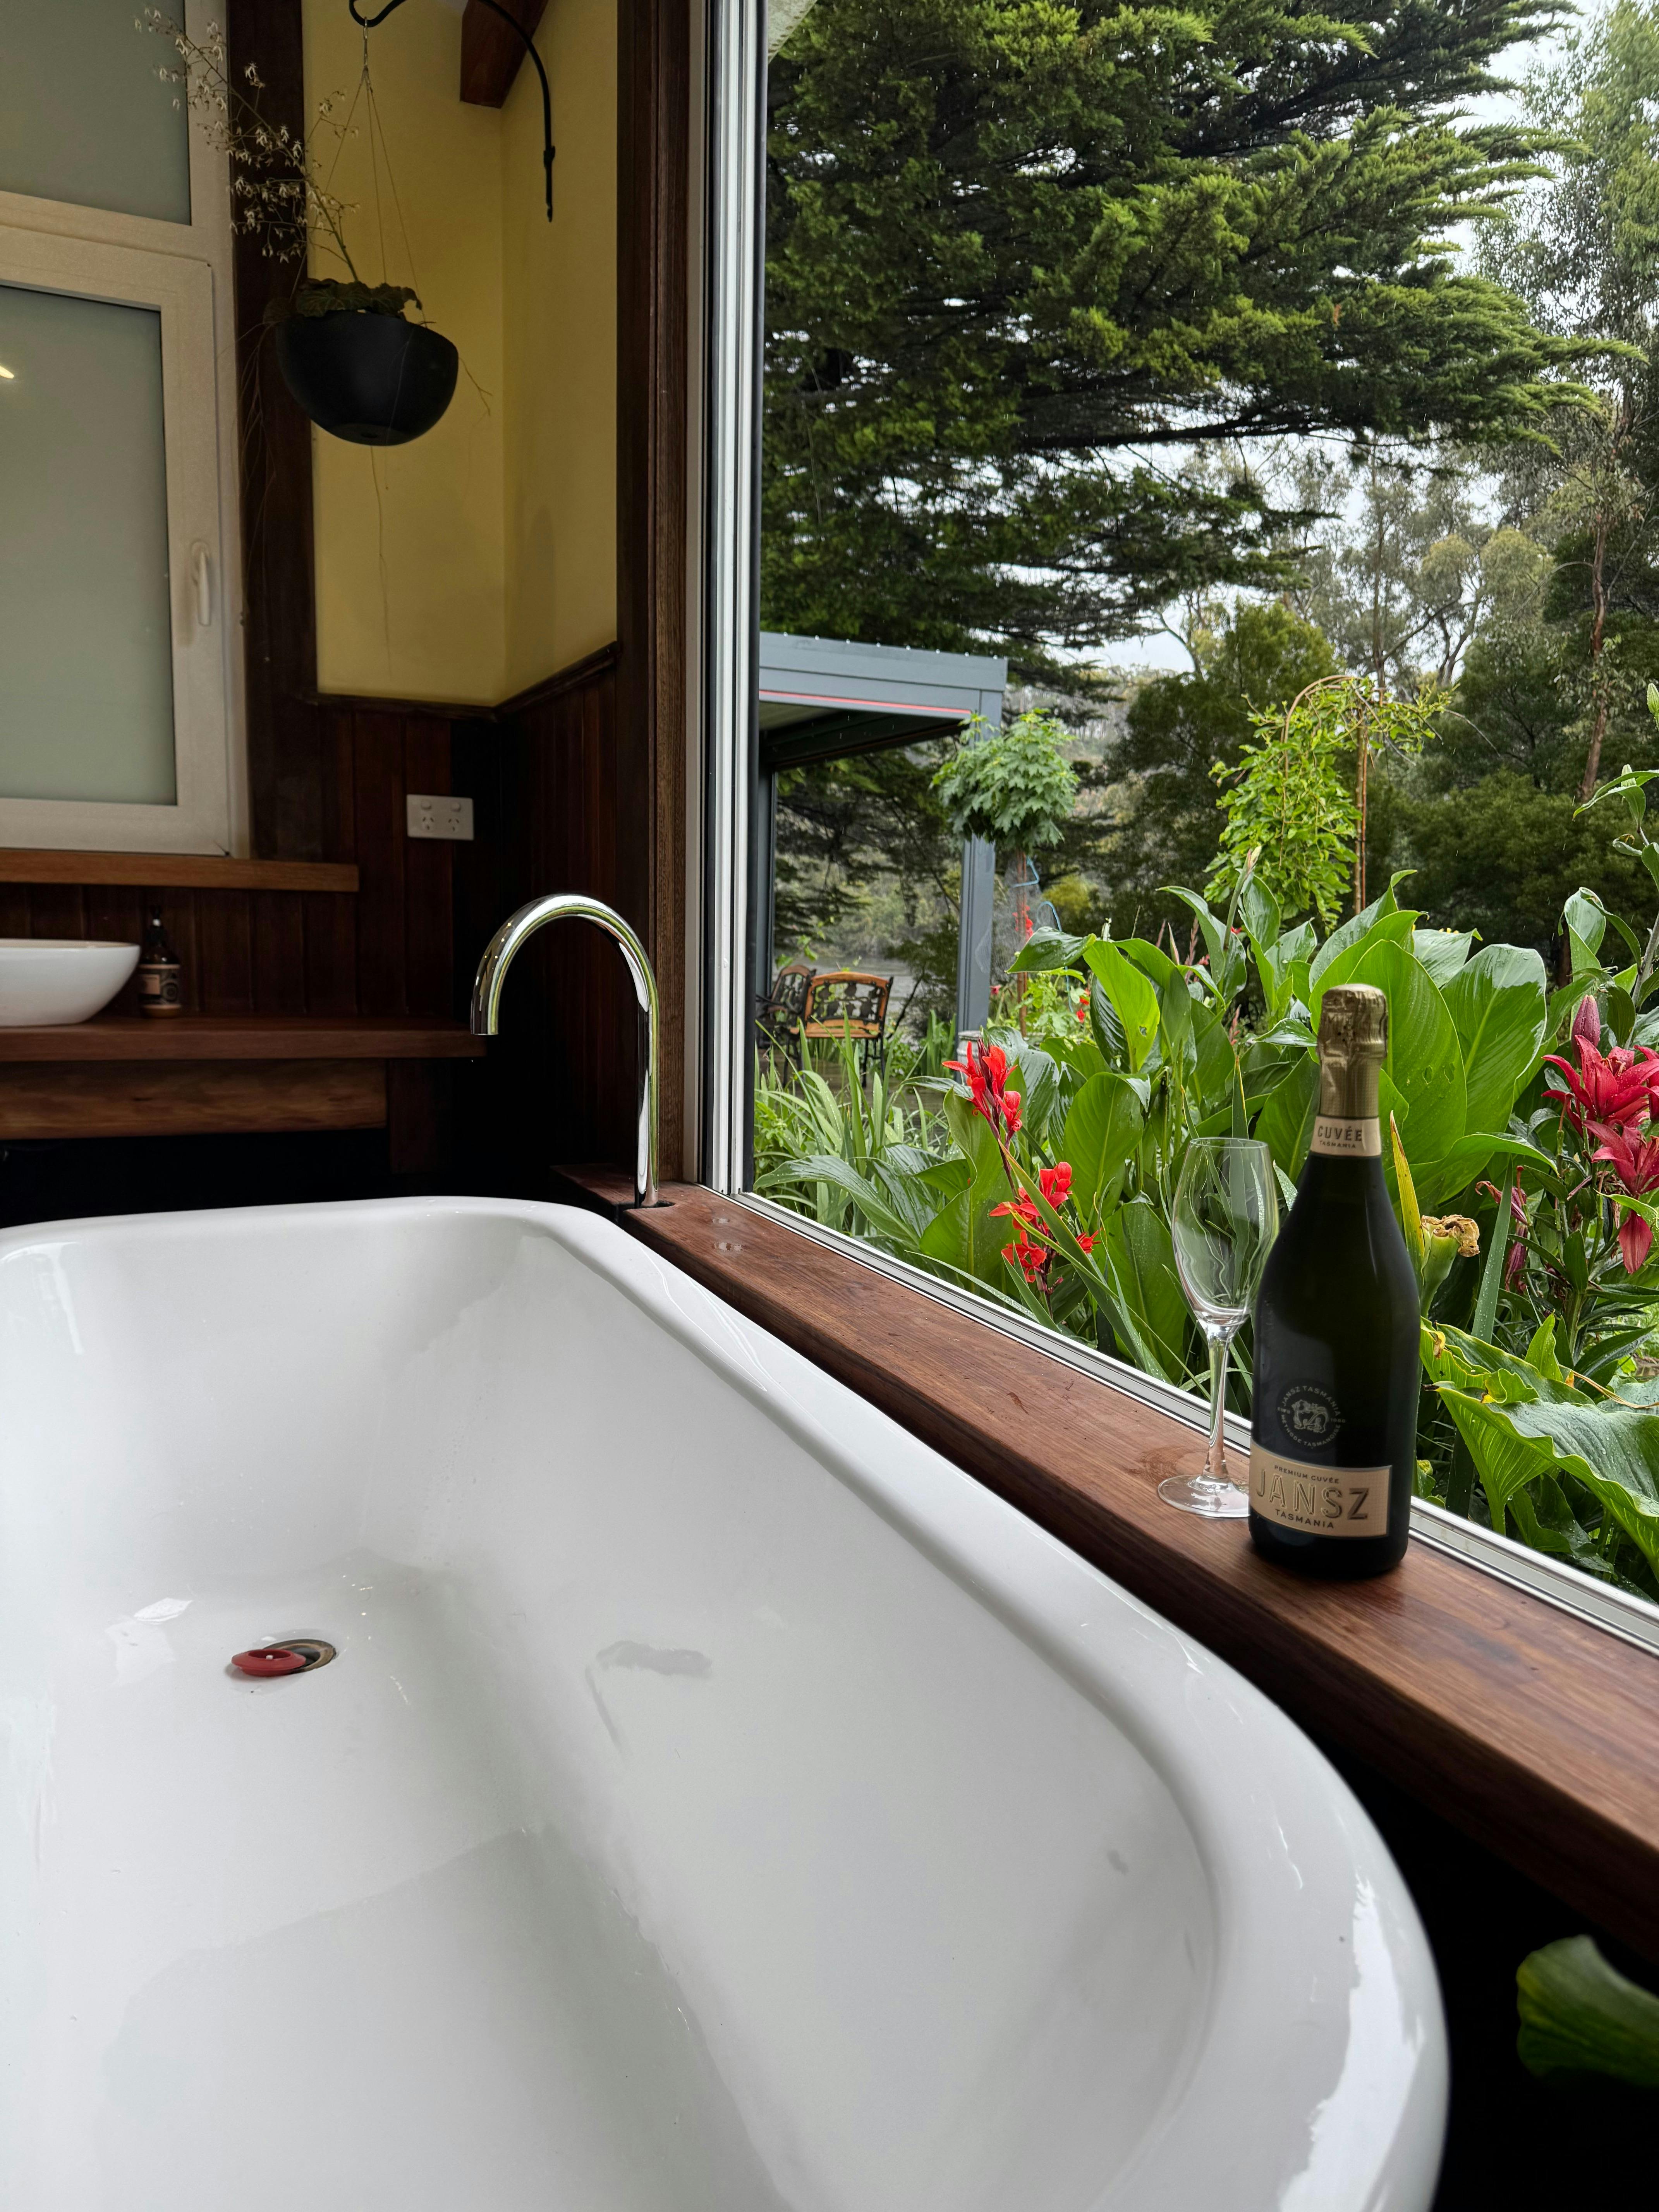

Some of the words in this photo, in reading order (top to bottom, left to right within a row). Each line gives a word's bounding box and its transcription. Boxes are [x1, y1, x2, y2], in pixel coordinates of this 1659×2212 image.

[1318, 1125, 1362, 1142] CUVÉE
[1282, 1386, 1301, 1407] JANSZ
[1302, 1385, 1341, 1416] TASMANIA
[1274, 1465, 1308, 1479] PREMIUM
[1311, 1475, 1340, 1484] CUVÉE
[1256, 1468, 1369, 1520] JANSZ
[1275, 1508, 1334, 1529] TASMANIA
